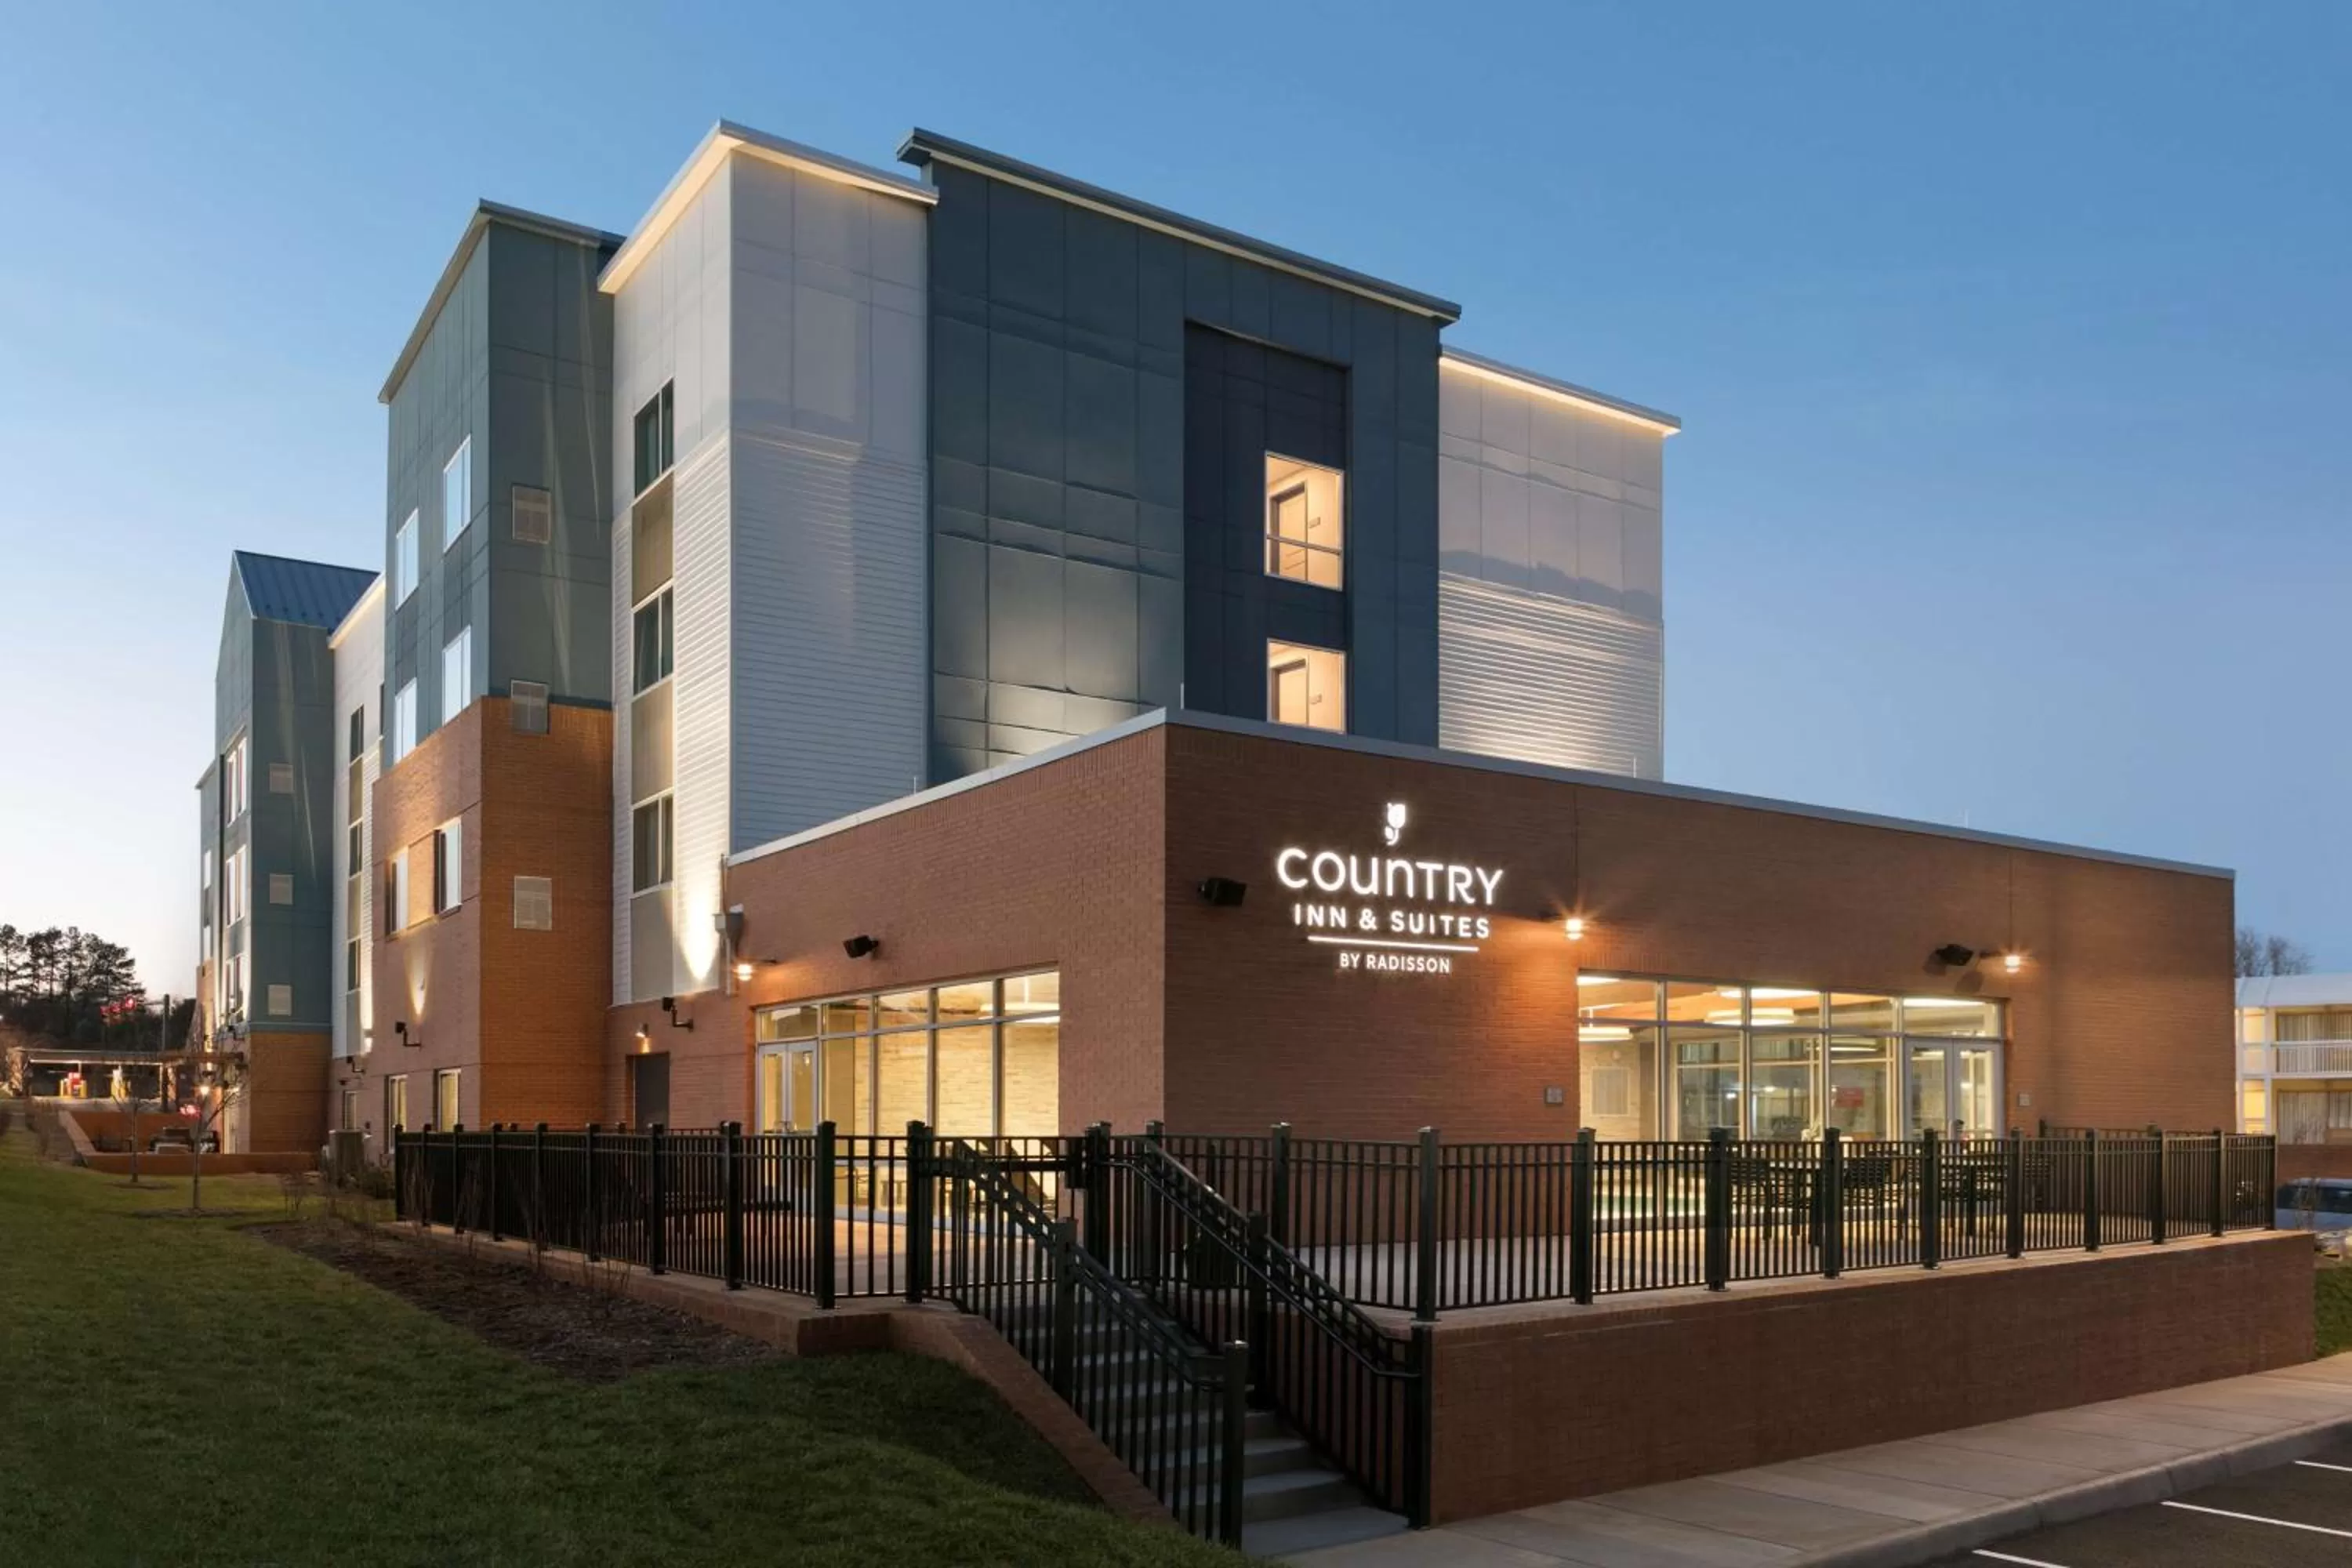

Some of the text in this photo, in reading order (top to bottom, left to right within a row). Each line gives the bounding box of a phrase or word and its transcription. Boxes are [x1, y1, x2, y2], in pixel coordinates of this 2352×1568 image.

[1294, 903, 1490, 939] INN & SUITES
[1340, 953, 1450, 973] BY RADISSON
